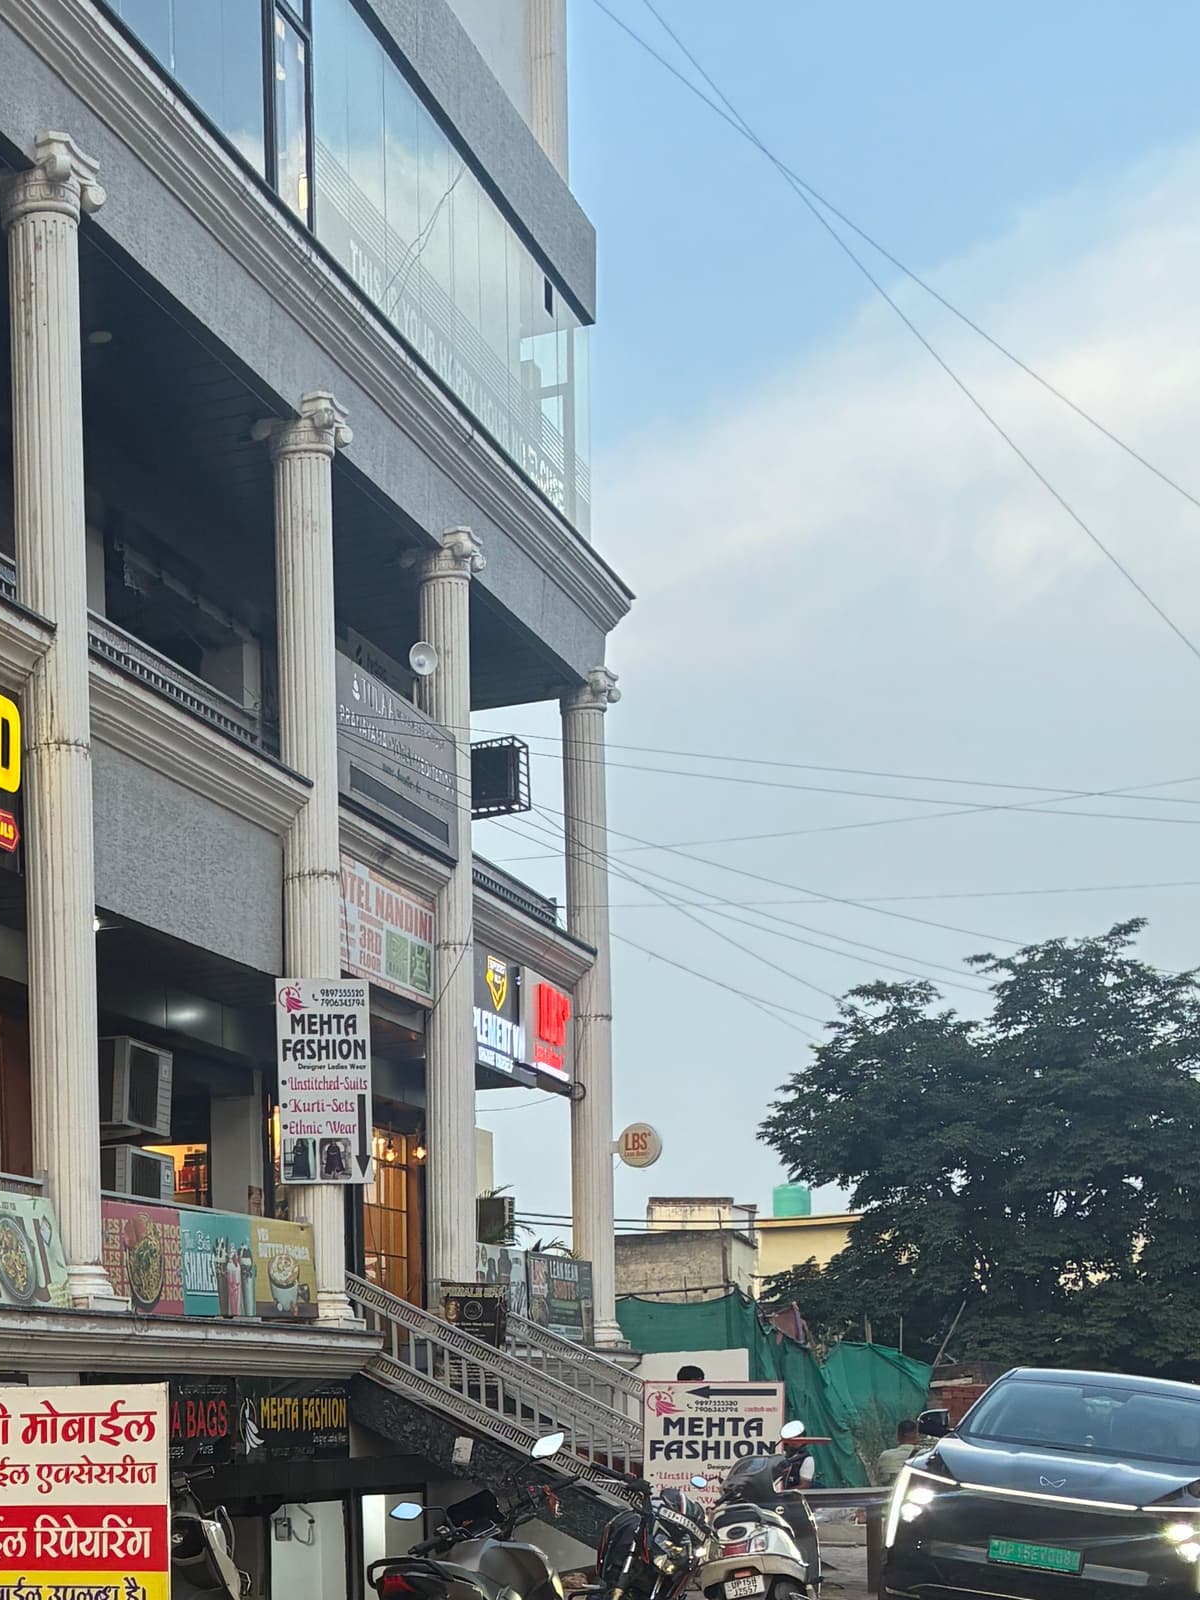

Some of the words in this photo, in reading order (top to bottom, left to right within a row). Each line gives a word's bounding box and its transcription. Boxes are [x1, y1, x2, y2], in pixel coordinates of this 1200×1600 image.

[375, 886, 433, 944] NANDINI
[359, 925, 382, 956] 3RD
[360, 950, 381, 973] FLOOR
[291, 1013, 357, 1037] MEHTA
[282, 1039, 367, 1062] FASHION
[288, 1076, 368, 1091] Unstitched-Suits
[288, 1099, 355, 1113] Kurti-Sets
[289, 1120, 323, 1135] Ethnic
[326, 1120, 358, 1135] Wear
[625, 1132, 648, 1151] LBS
[184, 1252, 218, 1291] SHAKES
[20, 1400, 158, 1446] मोबाईल
[185, 1399, 228, 1439] BAGS
[260, 1396, 299, 1432] MEHTA
[302, 1397, 347, 1432] FASHION
[663, 1417, 763, 1439] MEHTA
[650, 1440, 776, 1462] FASHION
[35, 1454, 158, 1494] एक्सेसरीज
[33, 1513, 153, 1561] रिपेयरिंग
